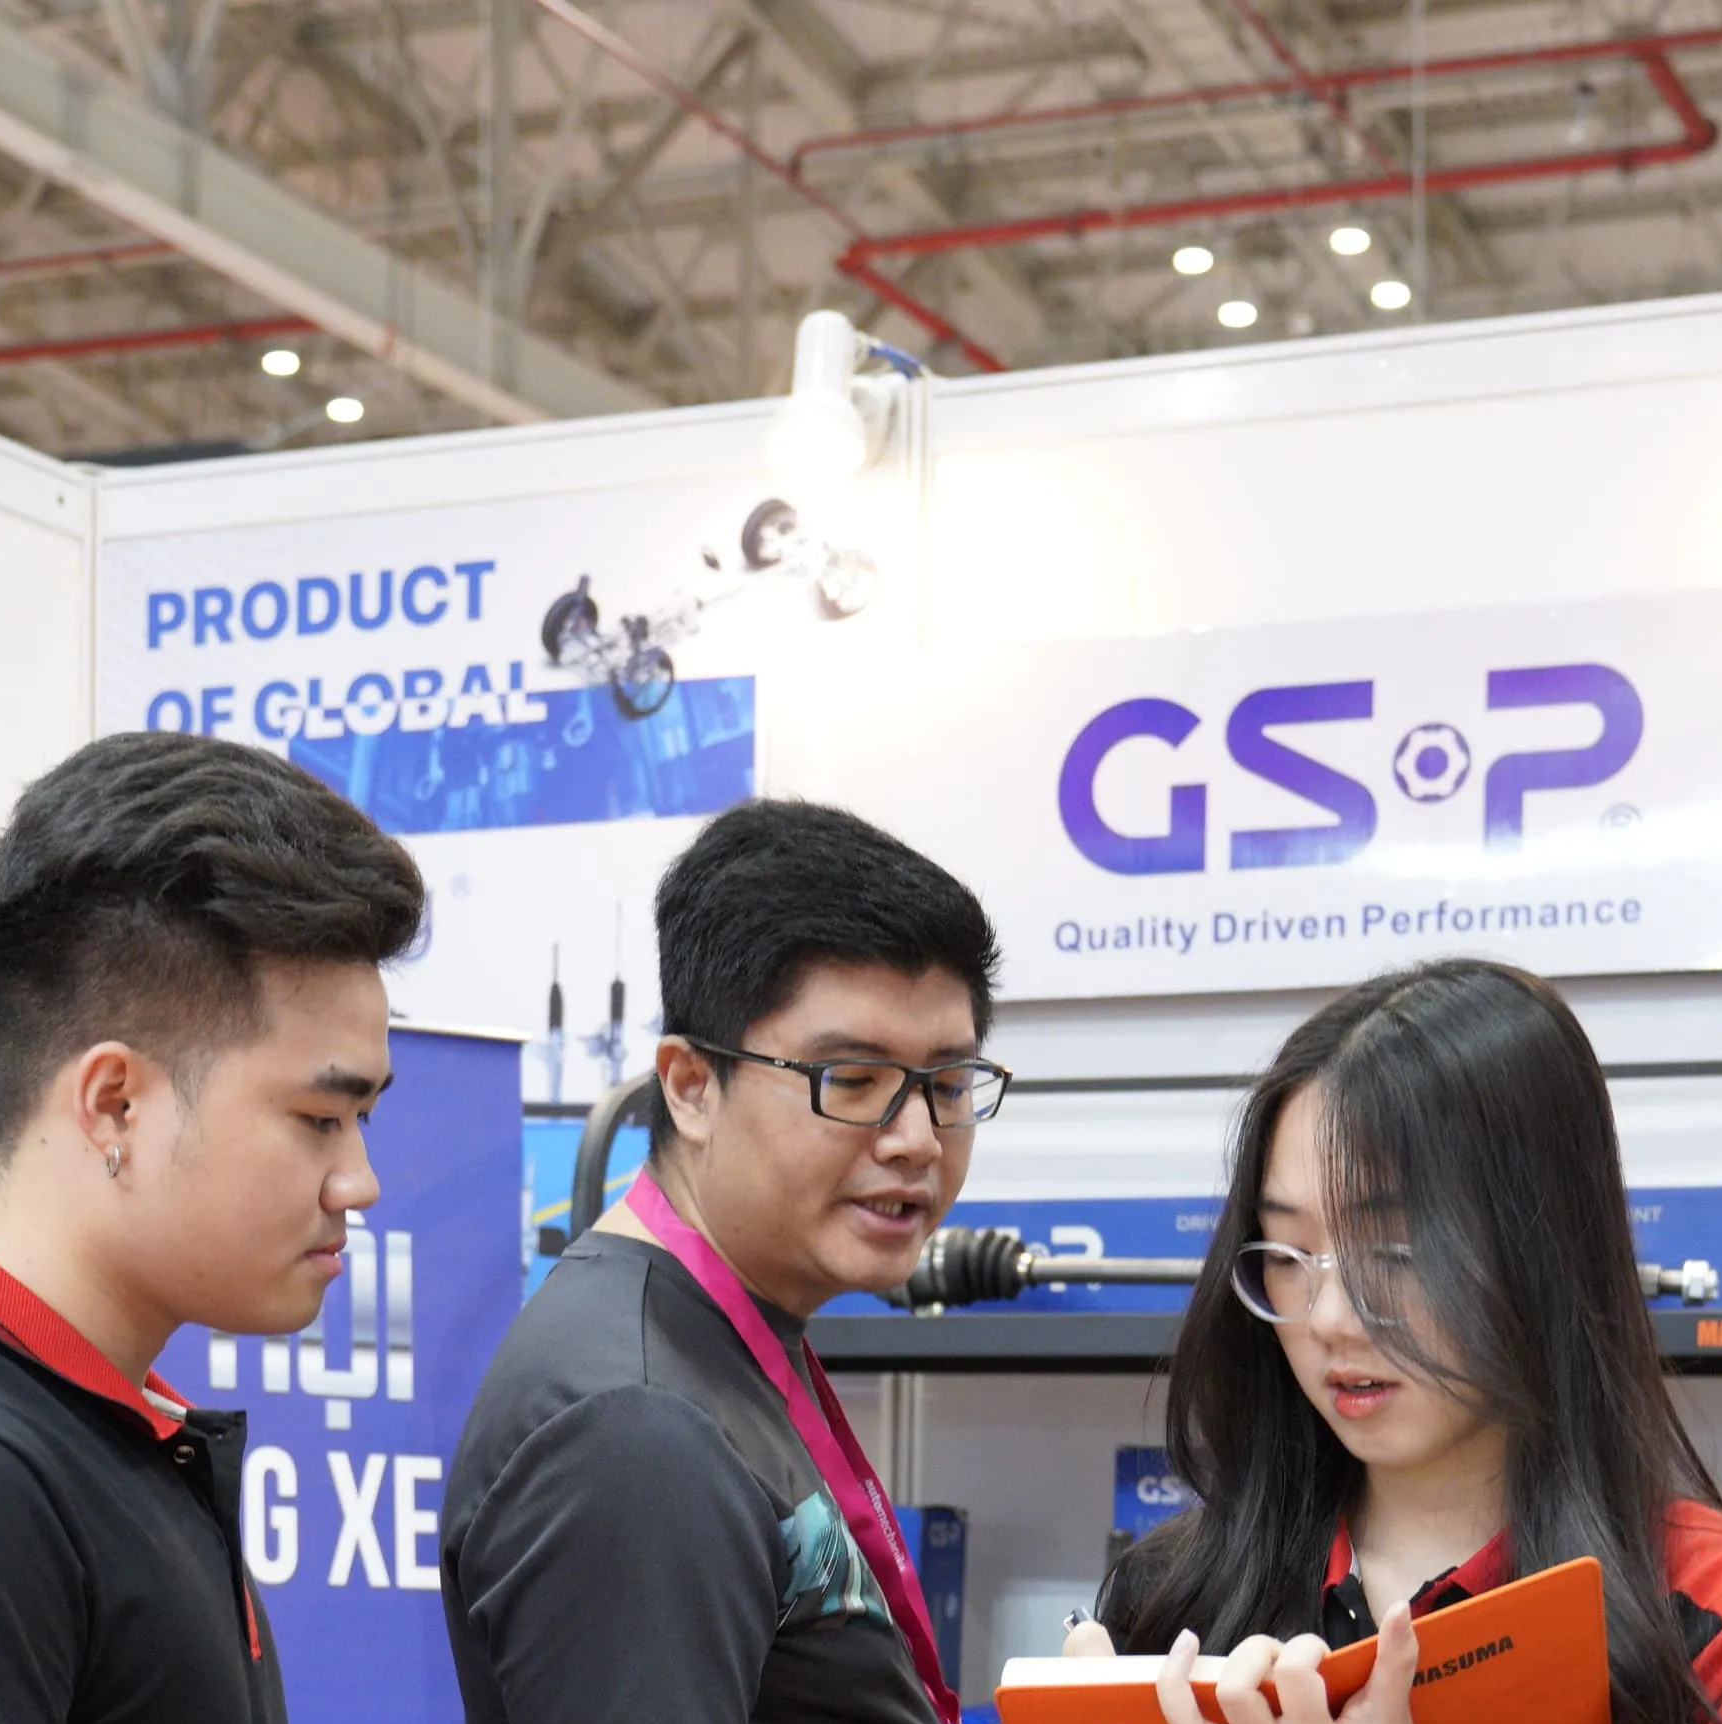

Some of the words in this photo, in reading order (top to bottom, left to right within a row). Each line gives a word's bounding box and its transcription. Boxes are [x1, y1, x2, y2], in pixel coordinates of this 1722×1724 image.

[146, 559, 495, 650] PRODUCT
[145, 686, 233, 735] OF
[253, 660, 548, 741] GLOBAL
[1058, 662, 1644, 875] GSP
[1054, 916, 1199, 955] Quality
[1212, 907, 1347, 944] Driven
[1362, 893, 1643, 936] Performance
[327, 1452, 442, 1592] XE
[863, 1478, 907, 1573] automechanika
[1413, 1636, 1515, 1688] MASUMA
